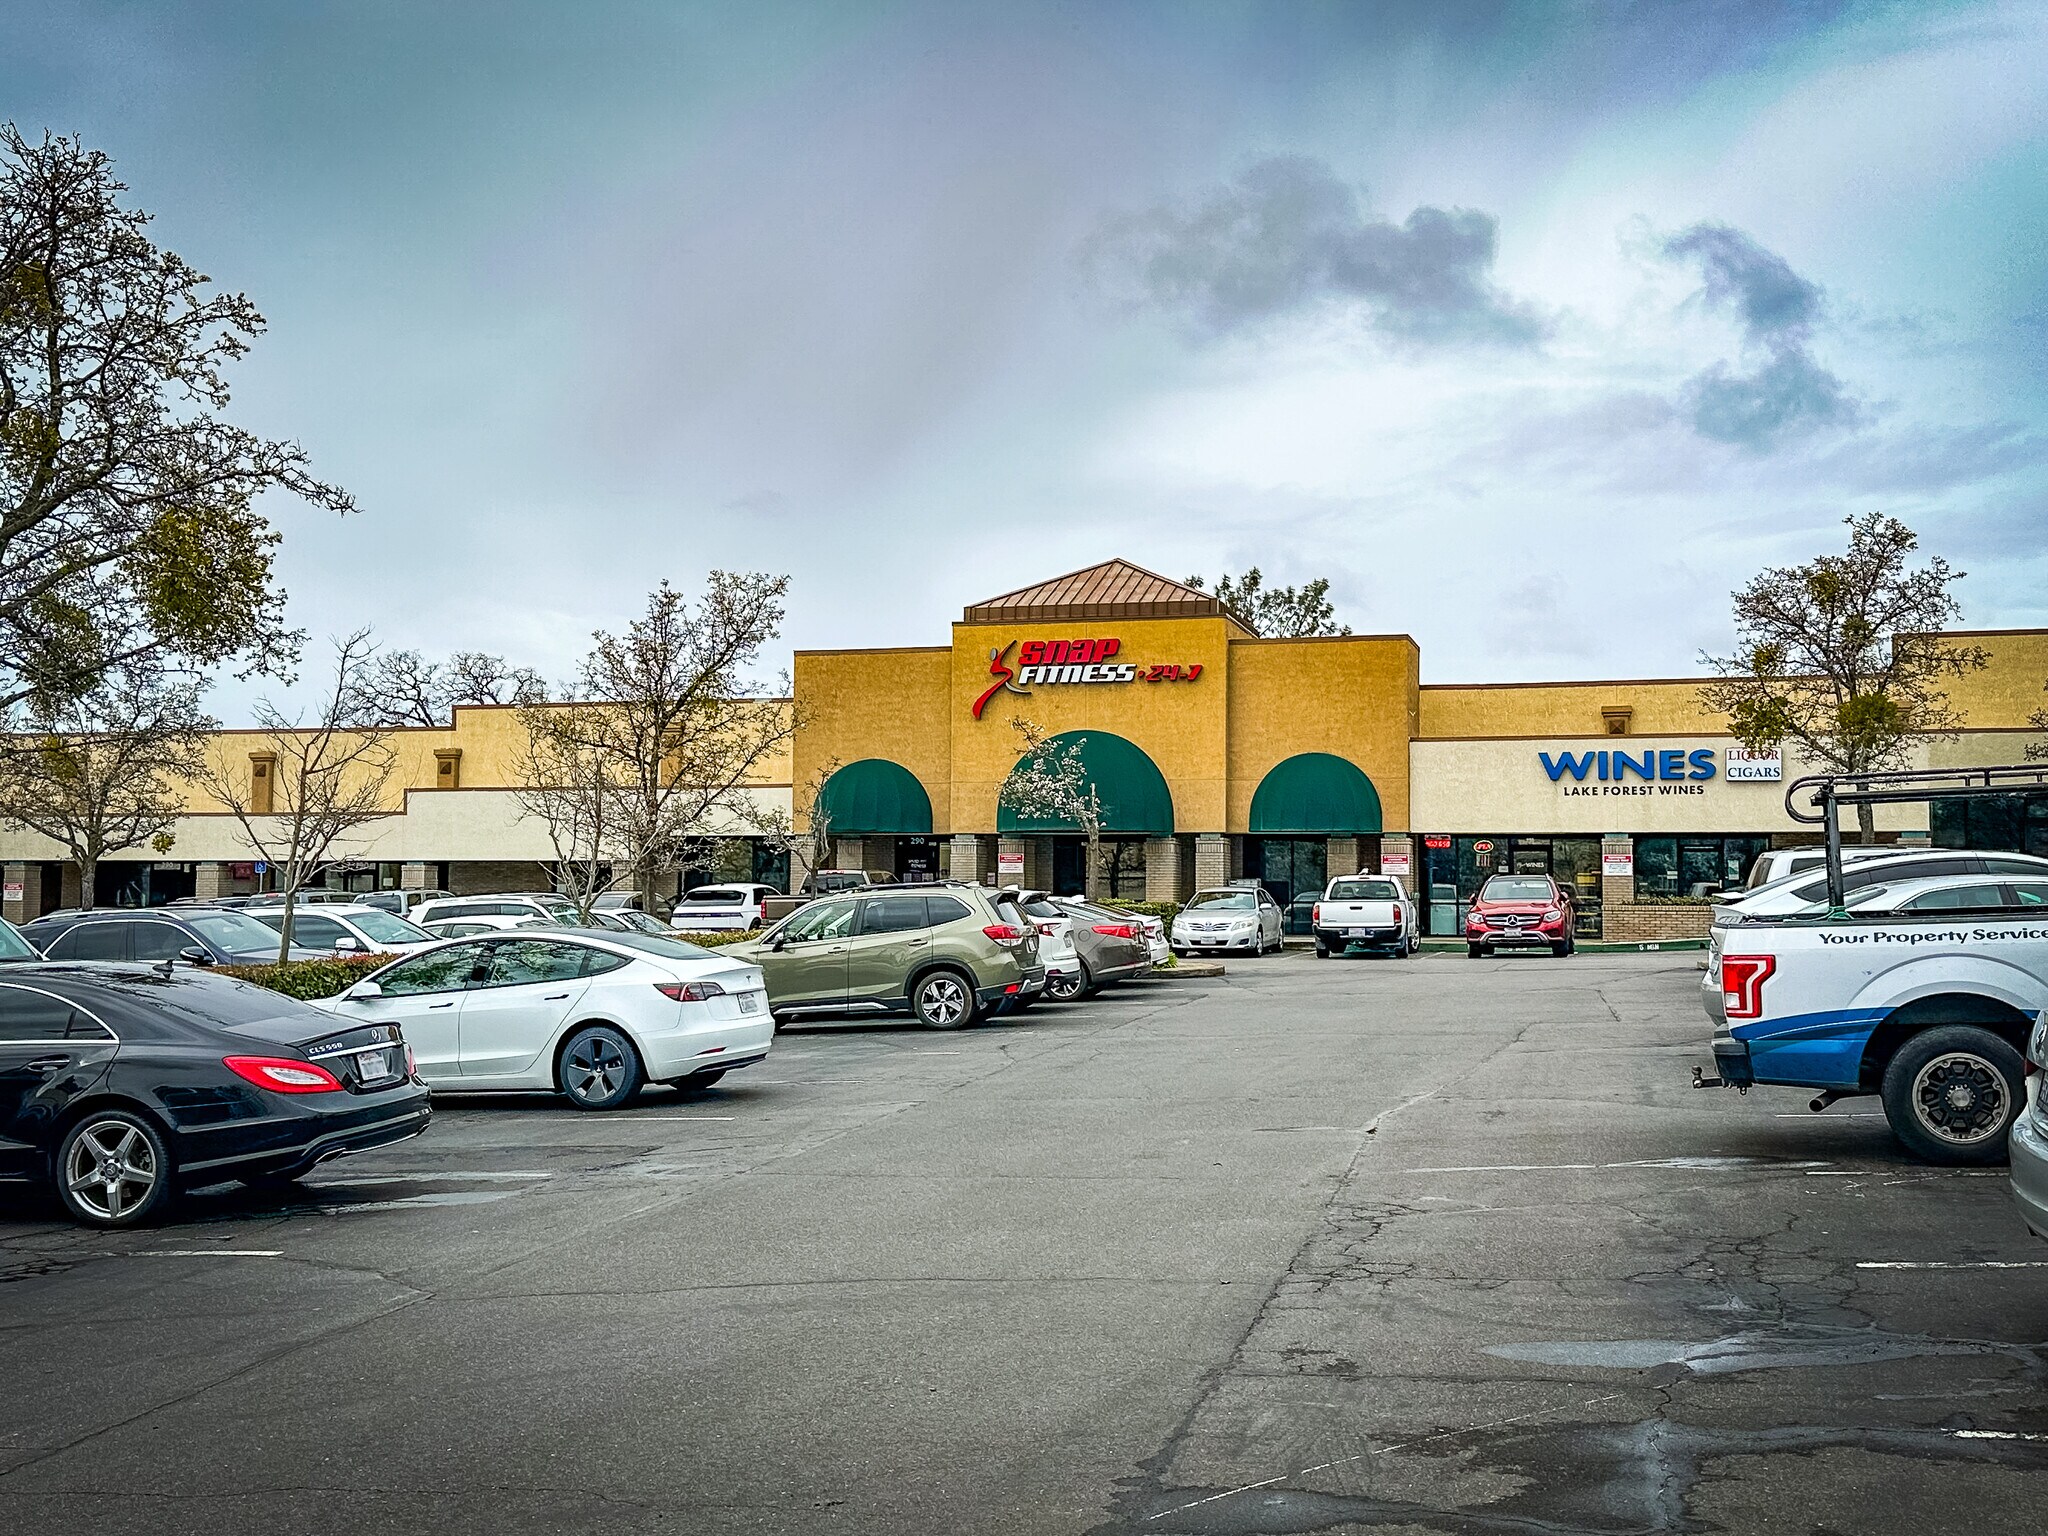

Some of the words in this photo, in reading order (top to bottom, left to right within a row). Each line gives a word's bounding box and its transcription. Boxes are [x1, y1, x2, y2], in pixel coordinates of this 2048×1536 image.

[1018, 664, 1137, 685] FITNESS
[1538, 749, 1717, 781] WINES
[1728, 767, 1780, 778] CIGARS
[1563, 786, 1599, 796] LAKE
[1603, 786, 1654, 796] FOREST
[1658, 785, 1704, 796] WINES
[1819, 932, 1868, 944] Your
[1873, 931, 1968, 945] Property
[1972, 927, 2048, 941] Service
